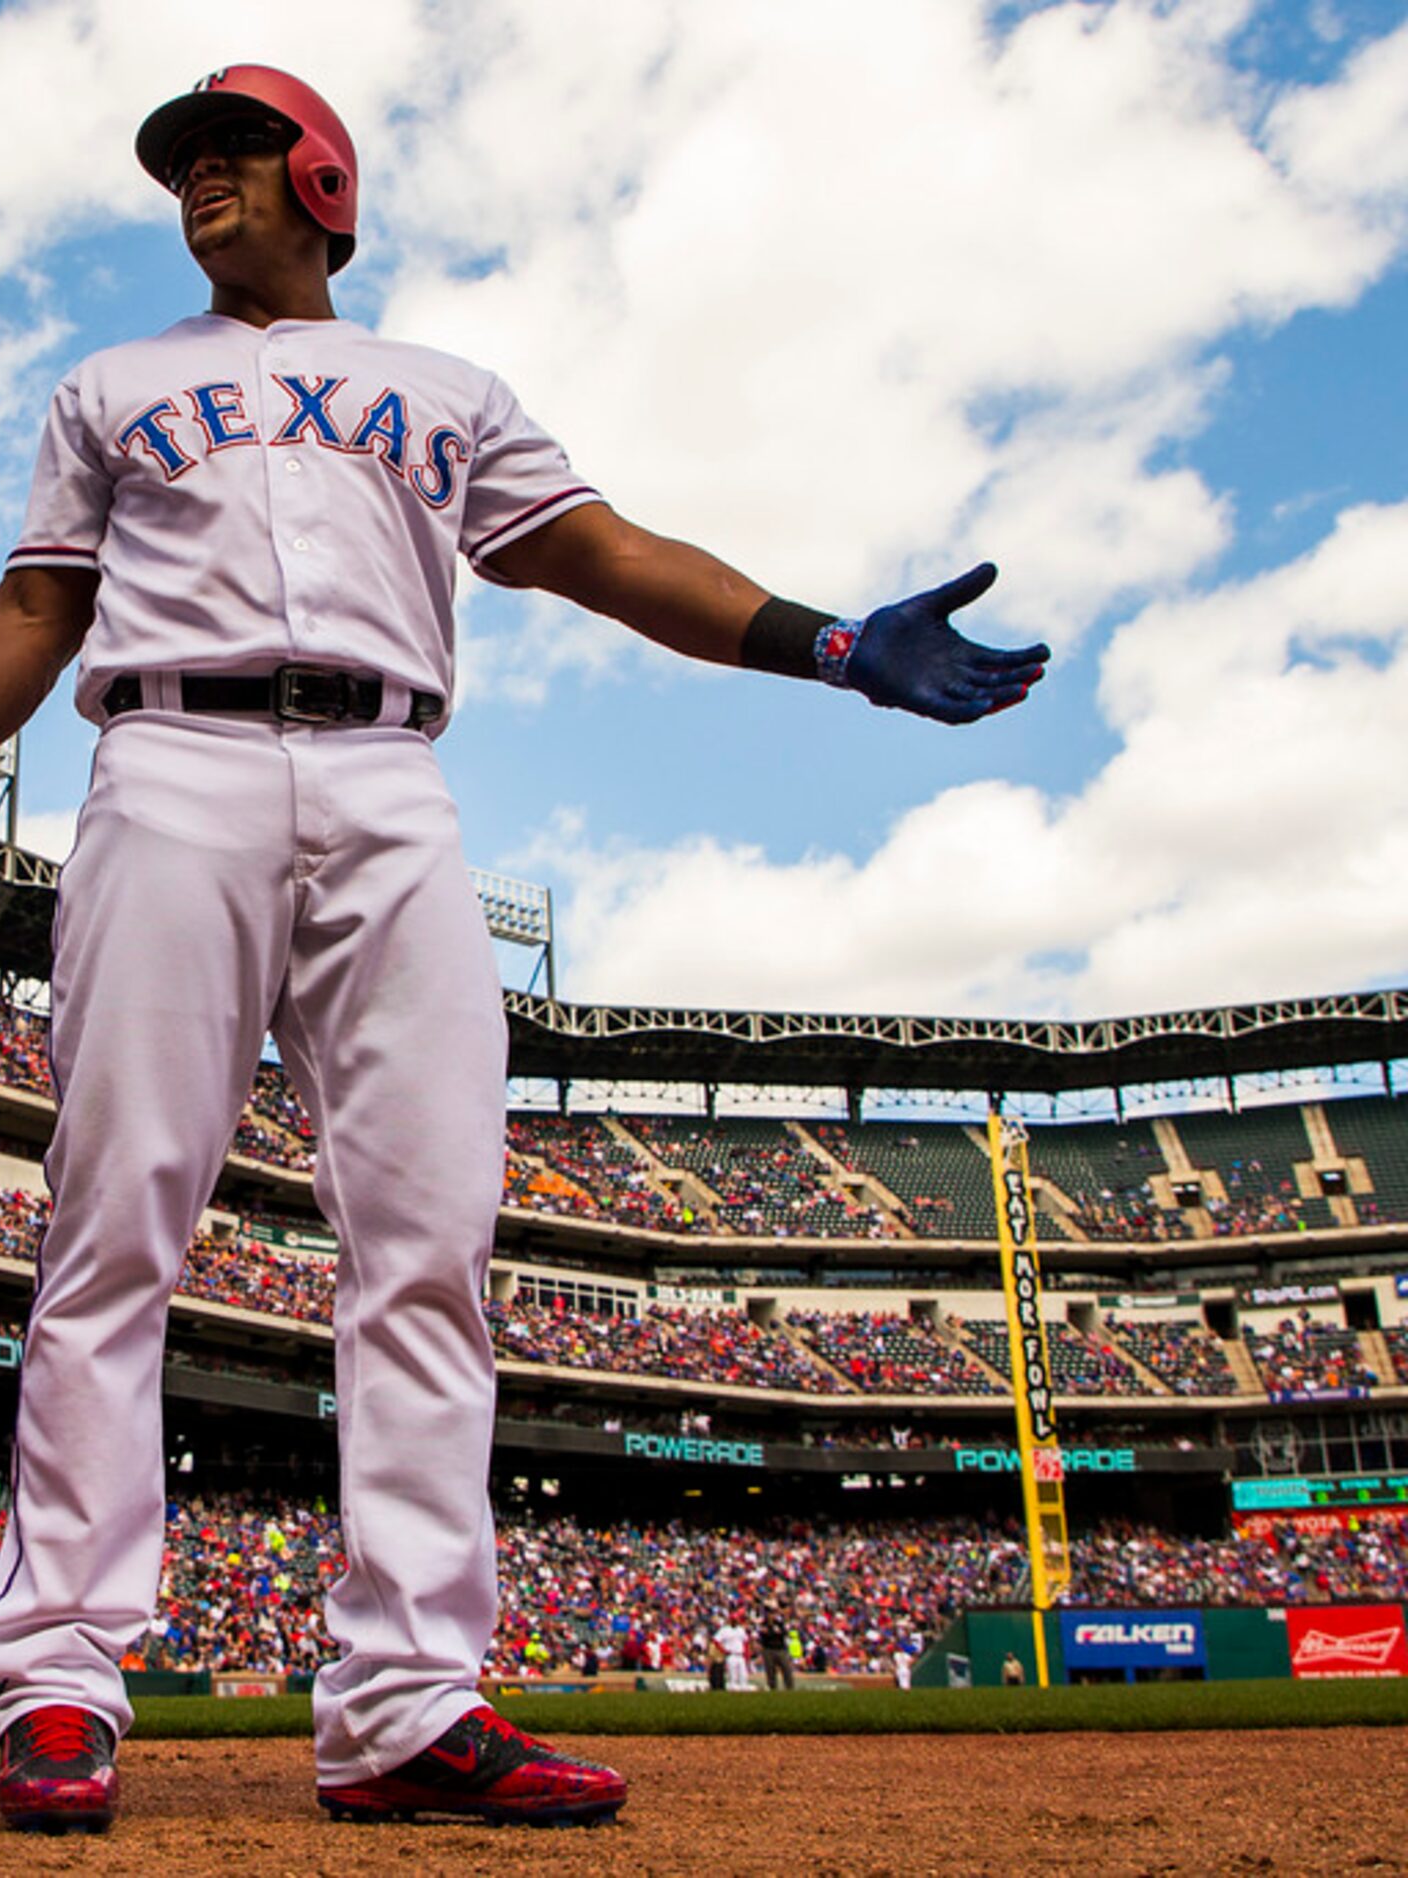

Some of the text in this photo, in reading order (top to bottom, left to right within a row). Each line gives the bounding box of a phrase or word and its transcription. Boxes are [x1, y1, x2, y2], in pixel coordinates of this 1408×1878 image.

[115, 374, 469, 510] TEXAS
[1004, 1171, 1028, 1245] EAT
[1014, 1253, 1038, 1330] MOR
[1023, 1337, 1055, 1440] FOWL
[625, 1433, 764, 1466] POWERADE
[1076, 1625, 1194, 1644] FALKEN
